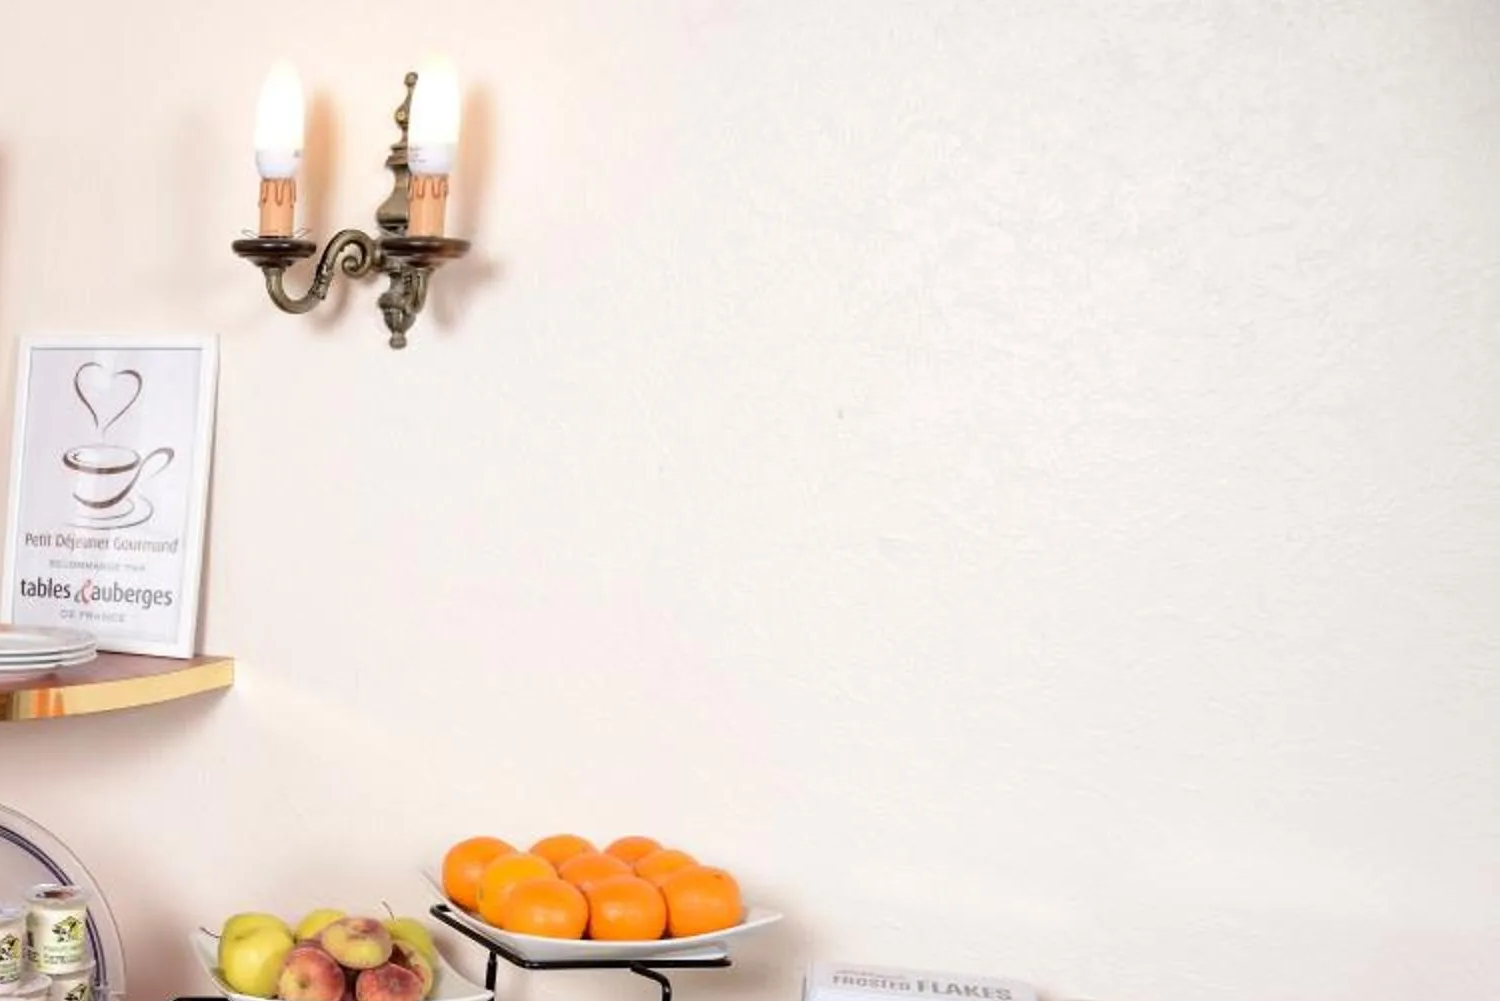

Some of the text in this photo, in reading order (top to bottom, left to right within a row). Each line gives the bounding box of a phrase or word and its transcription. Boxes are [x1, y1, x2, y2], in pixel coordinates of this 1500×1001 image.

[25, 533, 51, 548] Petit
[113, 538, 179, 554] Gourmand
[20, 577, 71, 599] tables
[91, 582, 173, 609] auberges
[79, 611, 125, 623] FRANCE
[833, 975, 1012, 1001] FROSTED FLAKES
